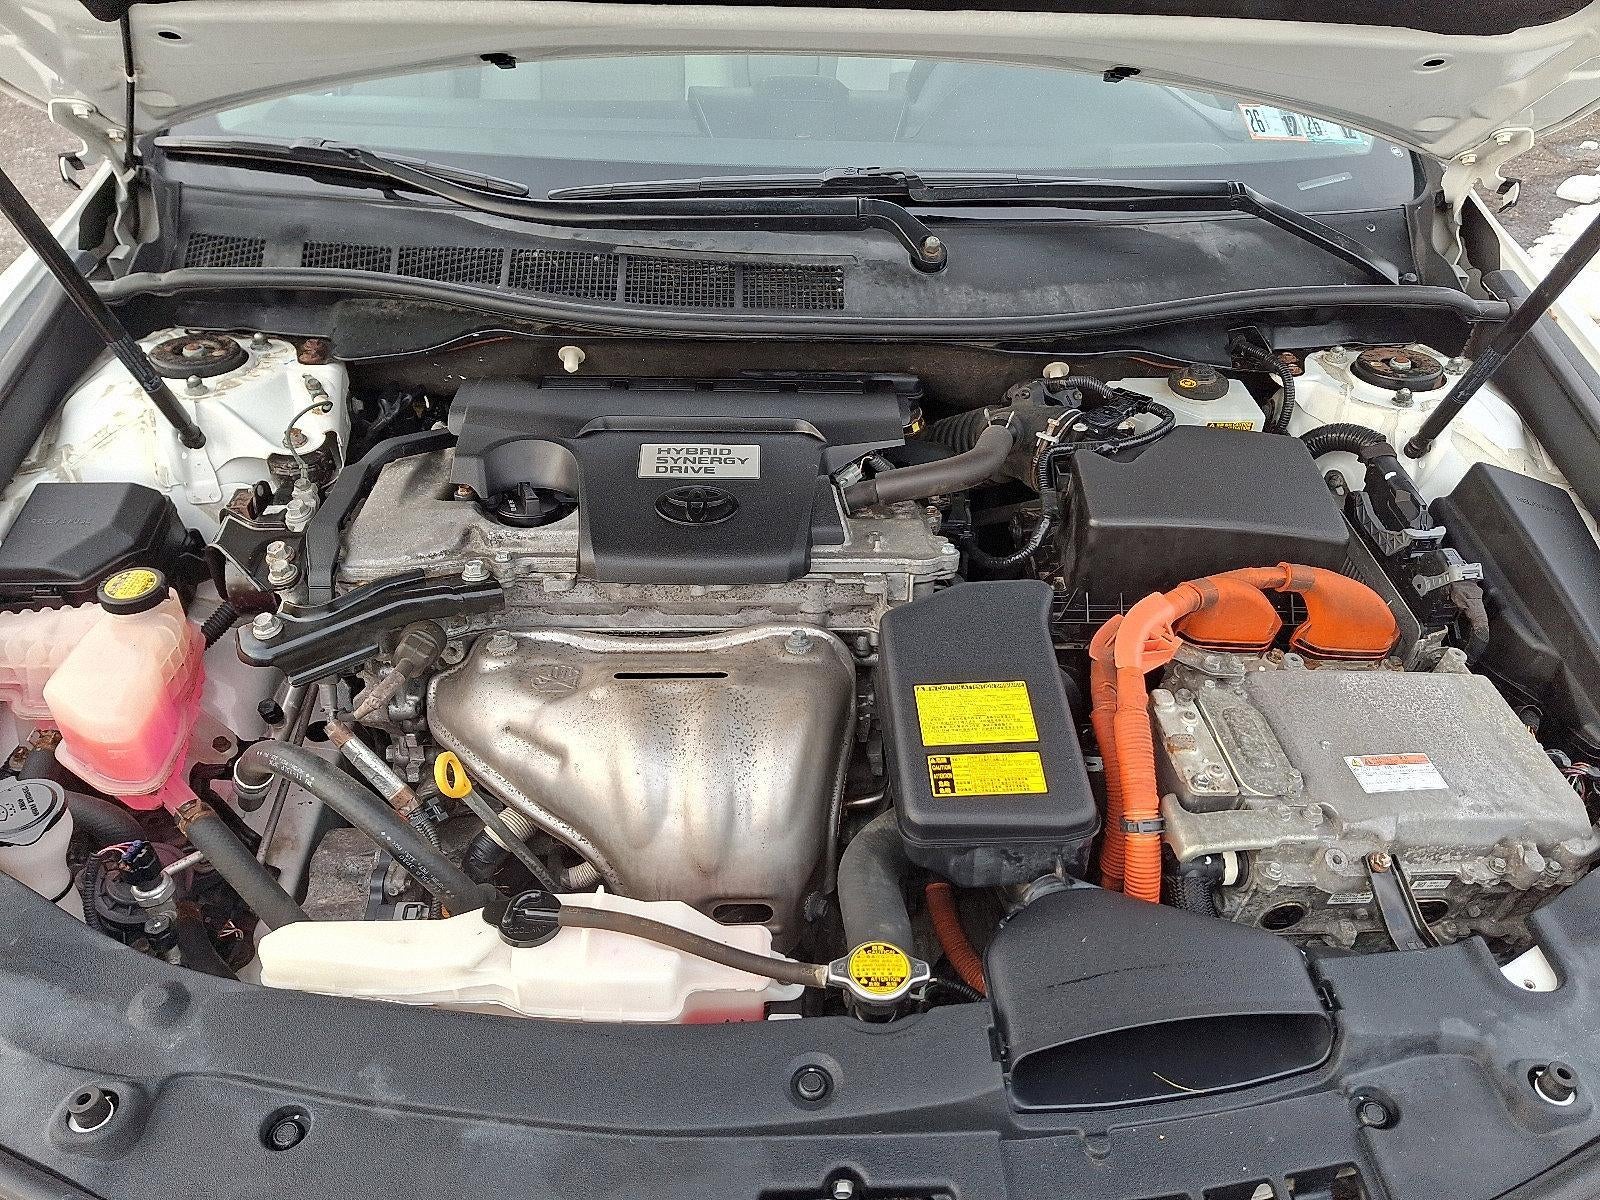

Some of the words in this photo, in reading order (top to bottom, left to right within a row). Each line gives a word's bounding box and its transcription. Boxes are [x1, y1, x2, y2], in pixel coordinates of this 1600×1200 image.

[1245, 108, 1266, 133] 26
[656, 447, 732, 456] HYBRID
[655, 456, 750, 465] SYNERGY
[655, 466, 716, 475] DRIVE
